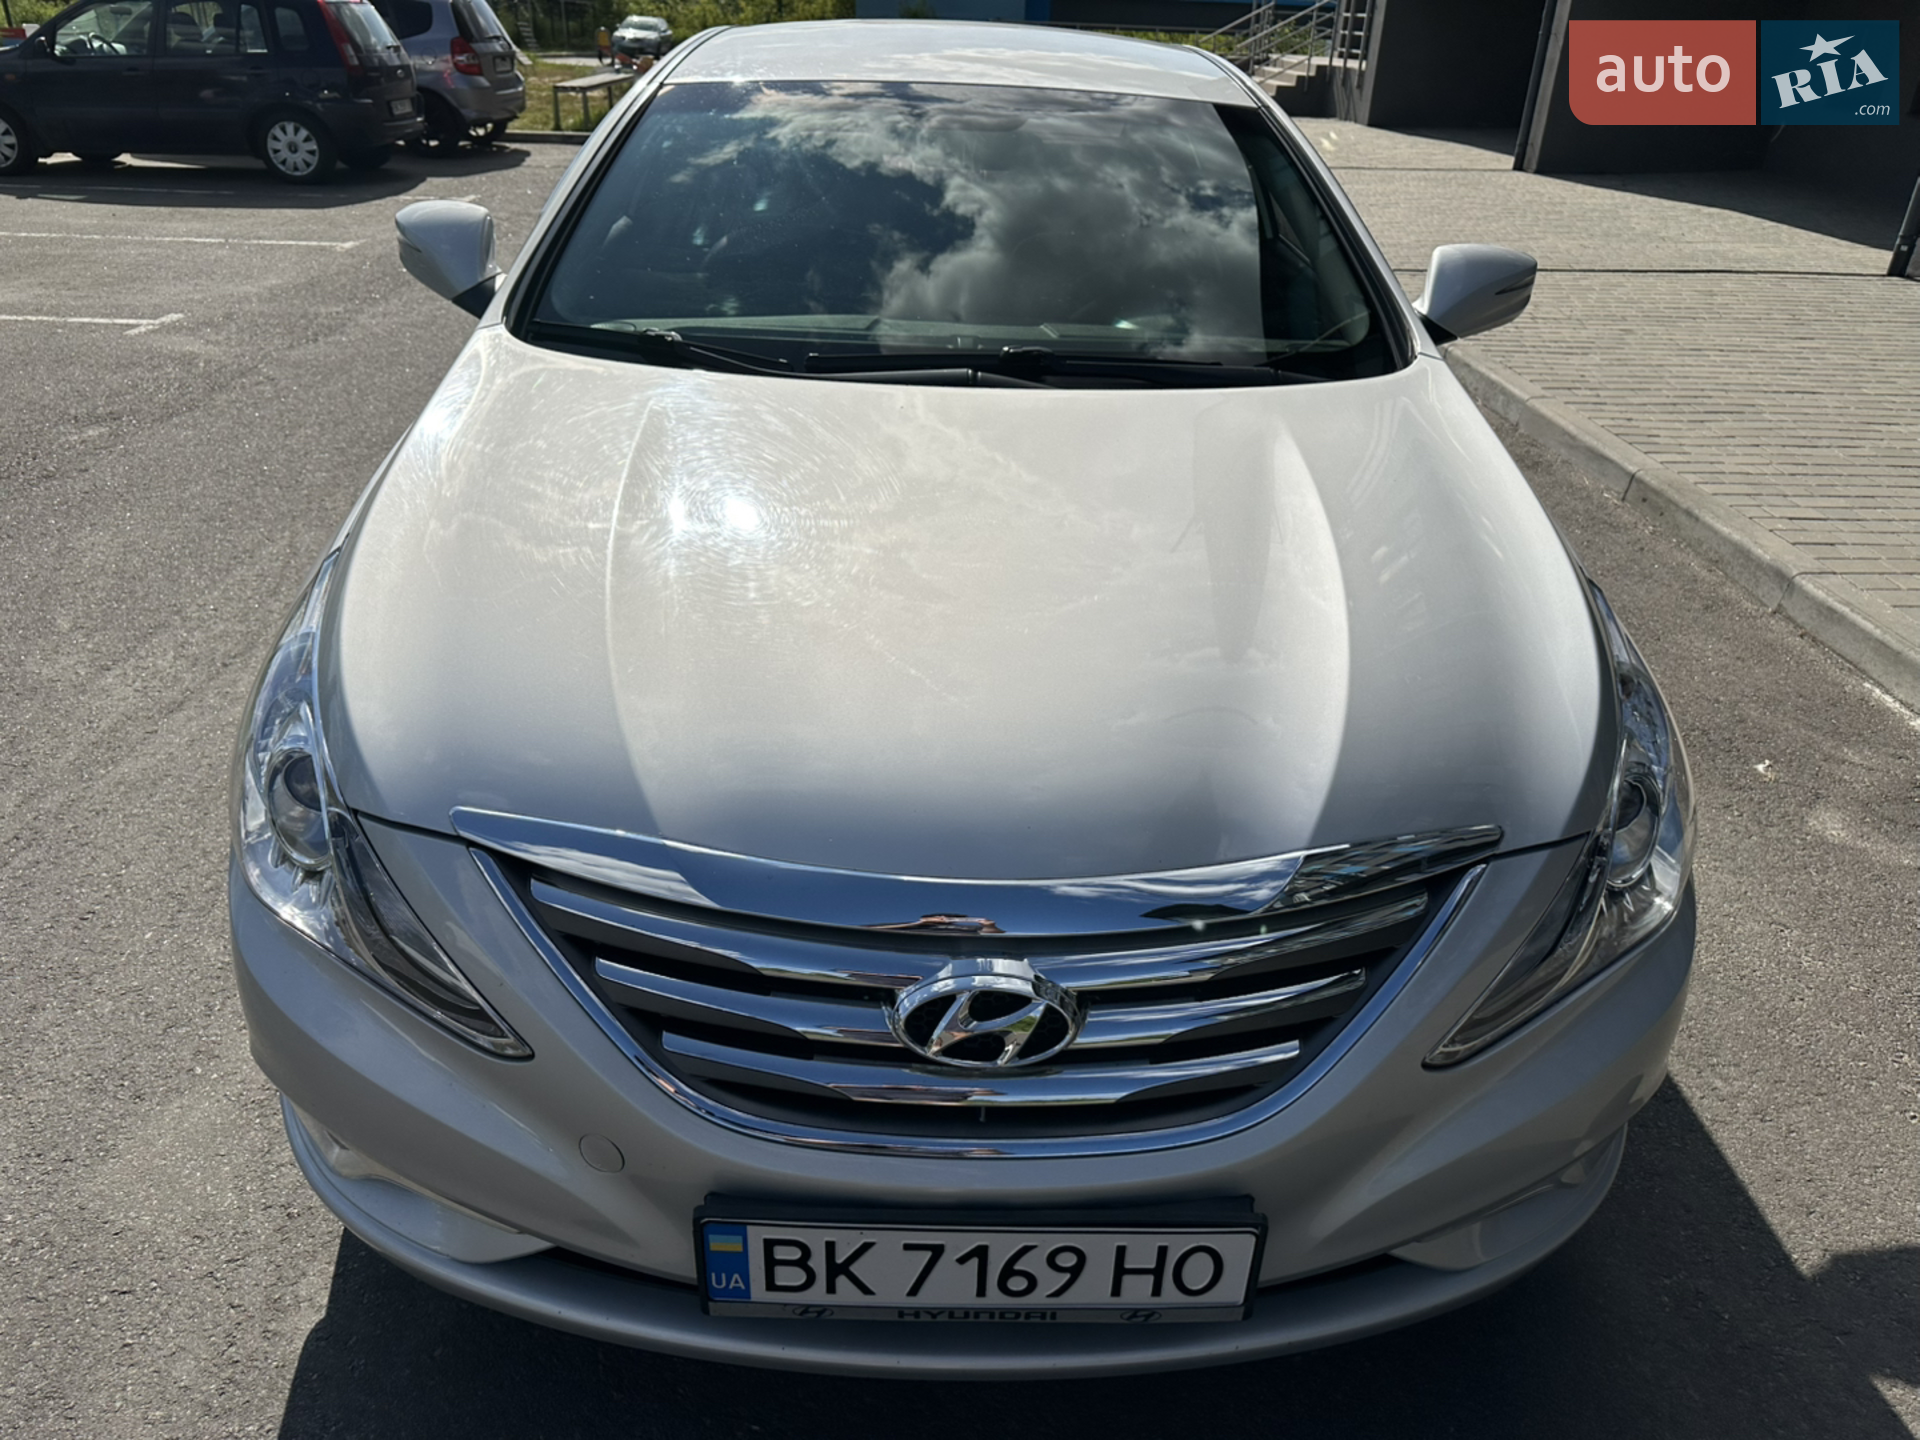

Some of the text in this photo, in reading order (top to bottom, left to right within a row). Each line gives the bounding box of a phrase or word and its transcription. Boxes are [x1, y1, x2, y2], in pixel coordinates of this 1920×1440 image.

[762, 1238, 1224, 1298] BK 7169 HO
[711, 1272, 745, 1290] UA
[897, 1309, 1057, 1321] HYUNDAI
